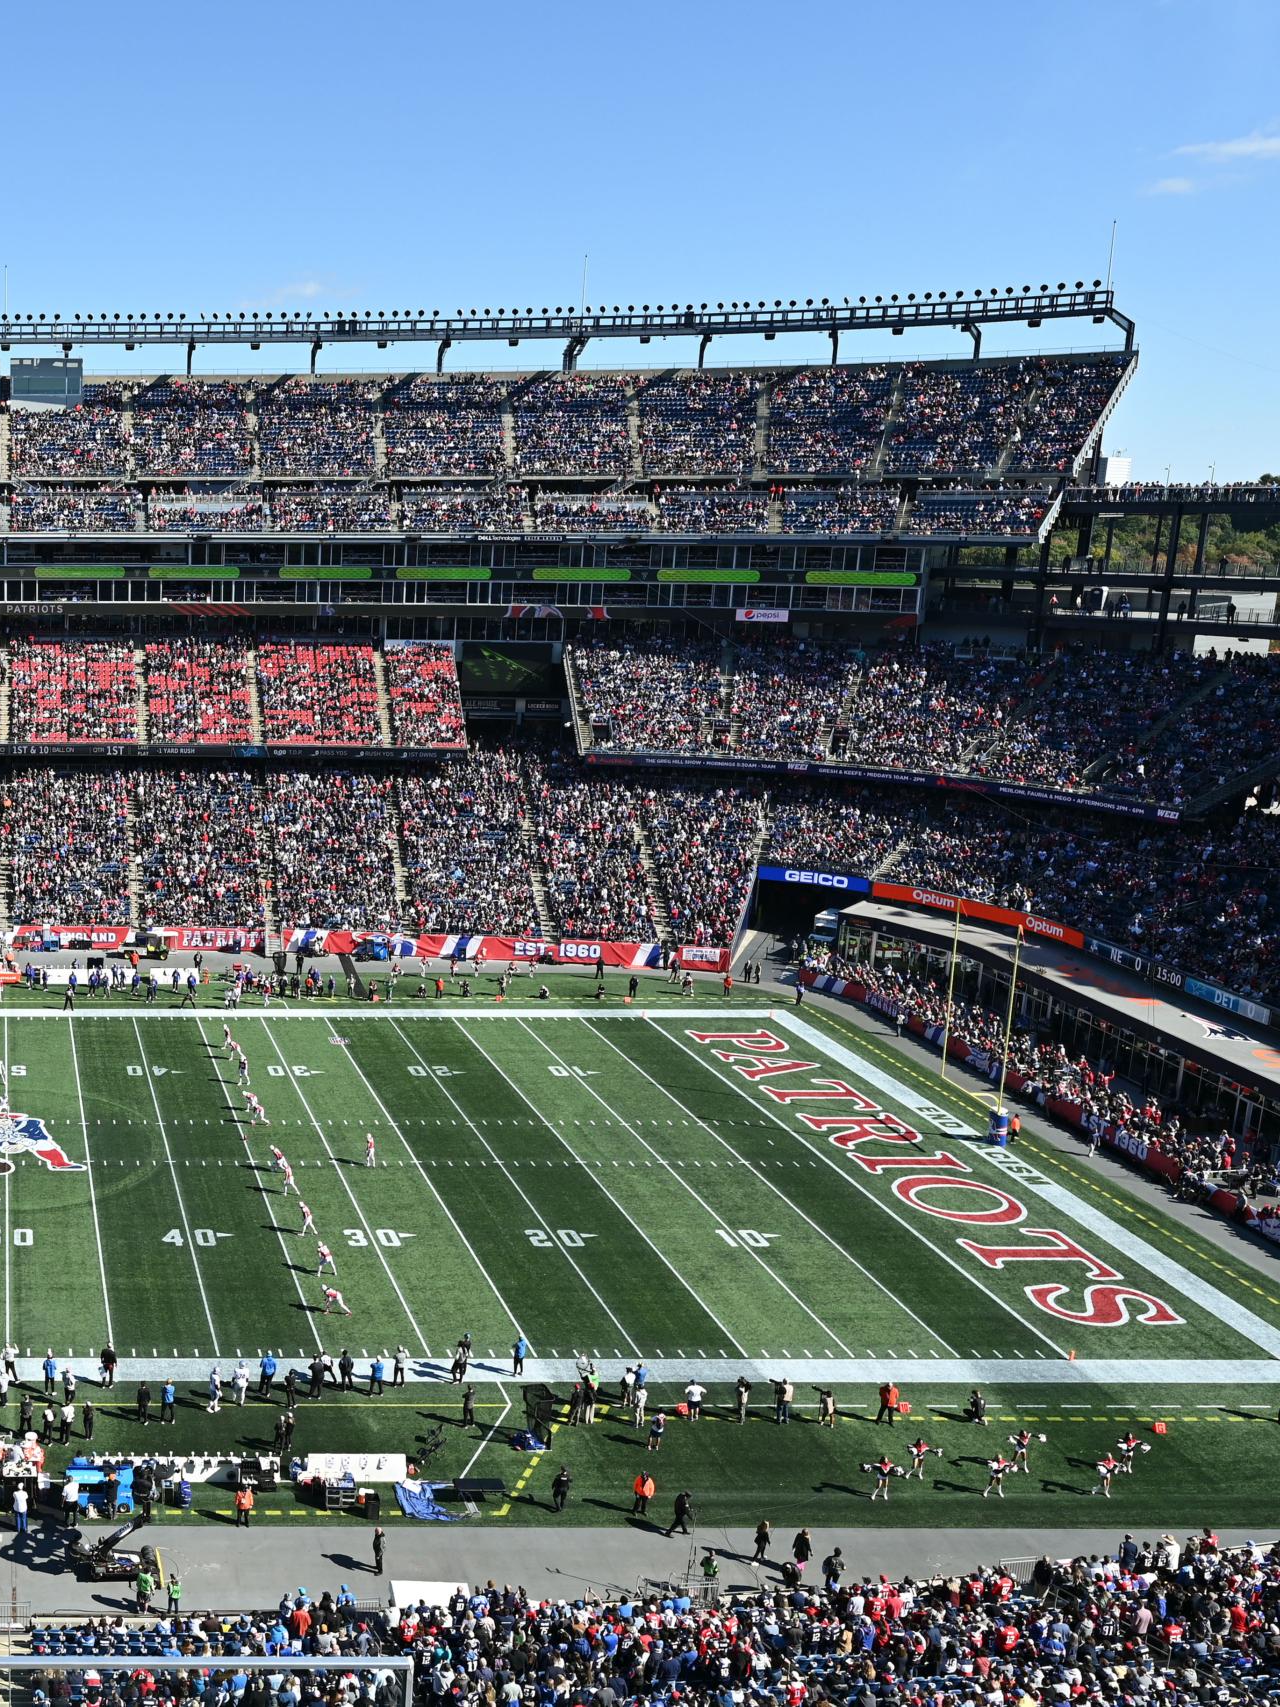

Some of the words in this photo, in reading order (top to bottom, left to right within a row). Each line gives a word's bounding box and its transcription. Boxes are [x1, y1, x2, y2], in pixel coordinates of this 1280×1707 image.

[6, 605, 63, 613] PATRIOTS
[12, 746, 28, 754] 1ST
[38, 746, 49, 754] 10
[106, 746, 124, 755] 1ST
[787, 763, 808, 771] WEEI
[866, 772, 892, 780] MIDDAYS
[1076, 798, 1115, 810] AFTERNOONS
[1156, 809, 1180, 820] WEEI
[784, 869, 849, 889] GEICO
[912, 889, 955, 909] Optum
[1025, 916, 1064, 938] Optum
[182, 930, 267, 948] PATRIOT
[514, 941, 551, 957] EST.
[559, 943, 601, 959] 1960
[1110, 949, 1123, 963] NE
[1135, 957, 1142, 971] 0
[1156, 966, 1182, 987] 15:00
[1214, 992, 1233, 1009] DET
[915, 1106, 964, 1128] END
[962, 1133, 1052, 1185] ACISM
[1113, 1123, 1148, 1160] 1960
[684, 1028, 1187, 1327] PATRIOTS
[162, 1229, 217, 1247] 40
[341, 1229, 402, 1247] 30
[524, 1229, 586, 1247] 20
[714, 1229, 770, 1247] 10
